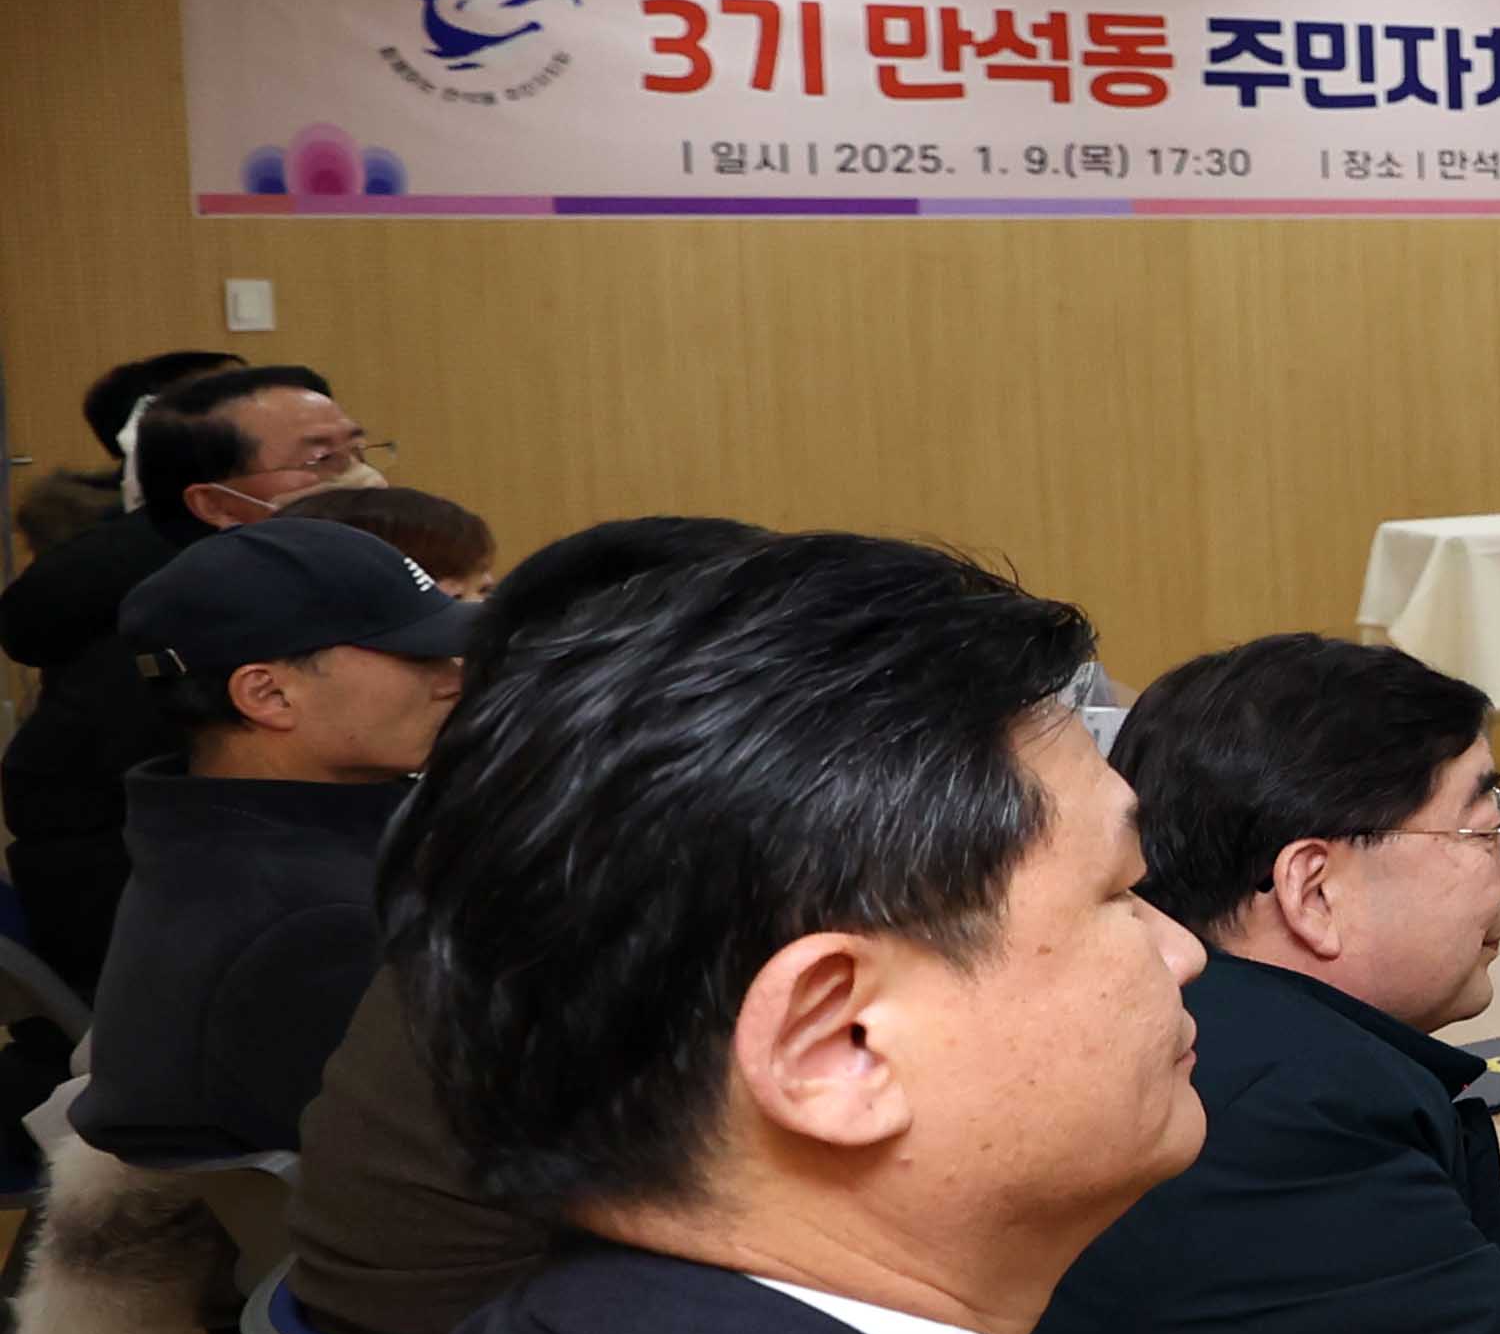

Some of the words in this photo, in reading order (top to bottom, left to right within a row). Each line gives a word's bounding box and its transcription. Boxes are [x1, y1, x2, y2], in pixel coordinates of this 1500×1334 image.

[865, 4, 1175, 110] 만석동
[834, 143, 956, 175] 2025.
[1147, 147, 1252, 177] 17:30
